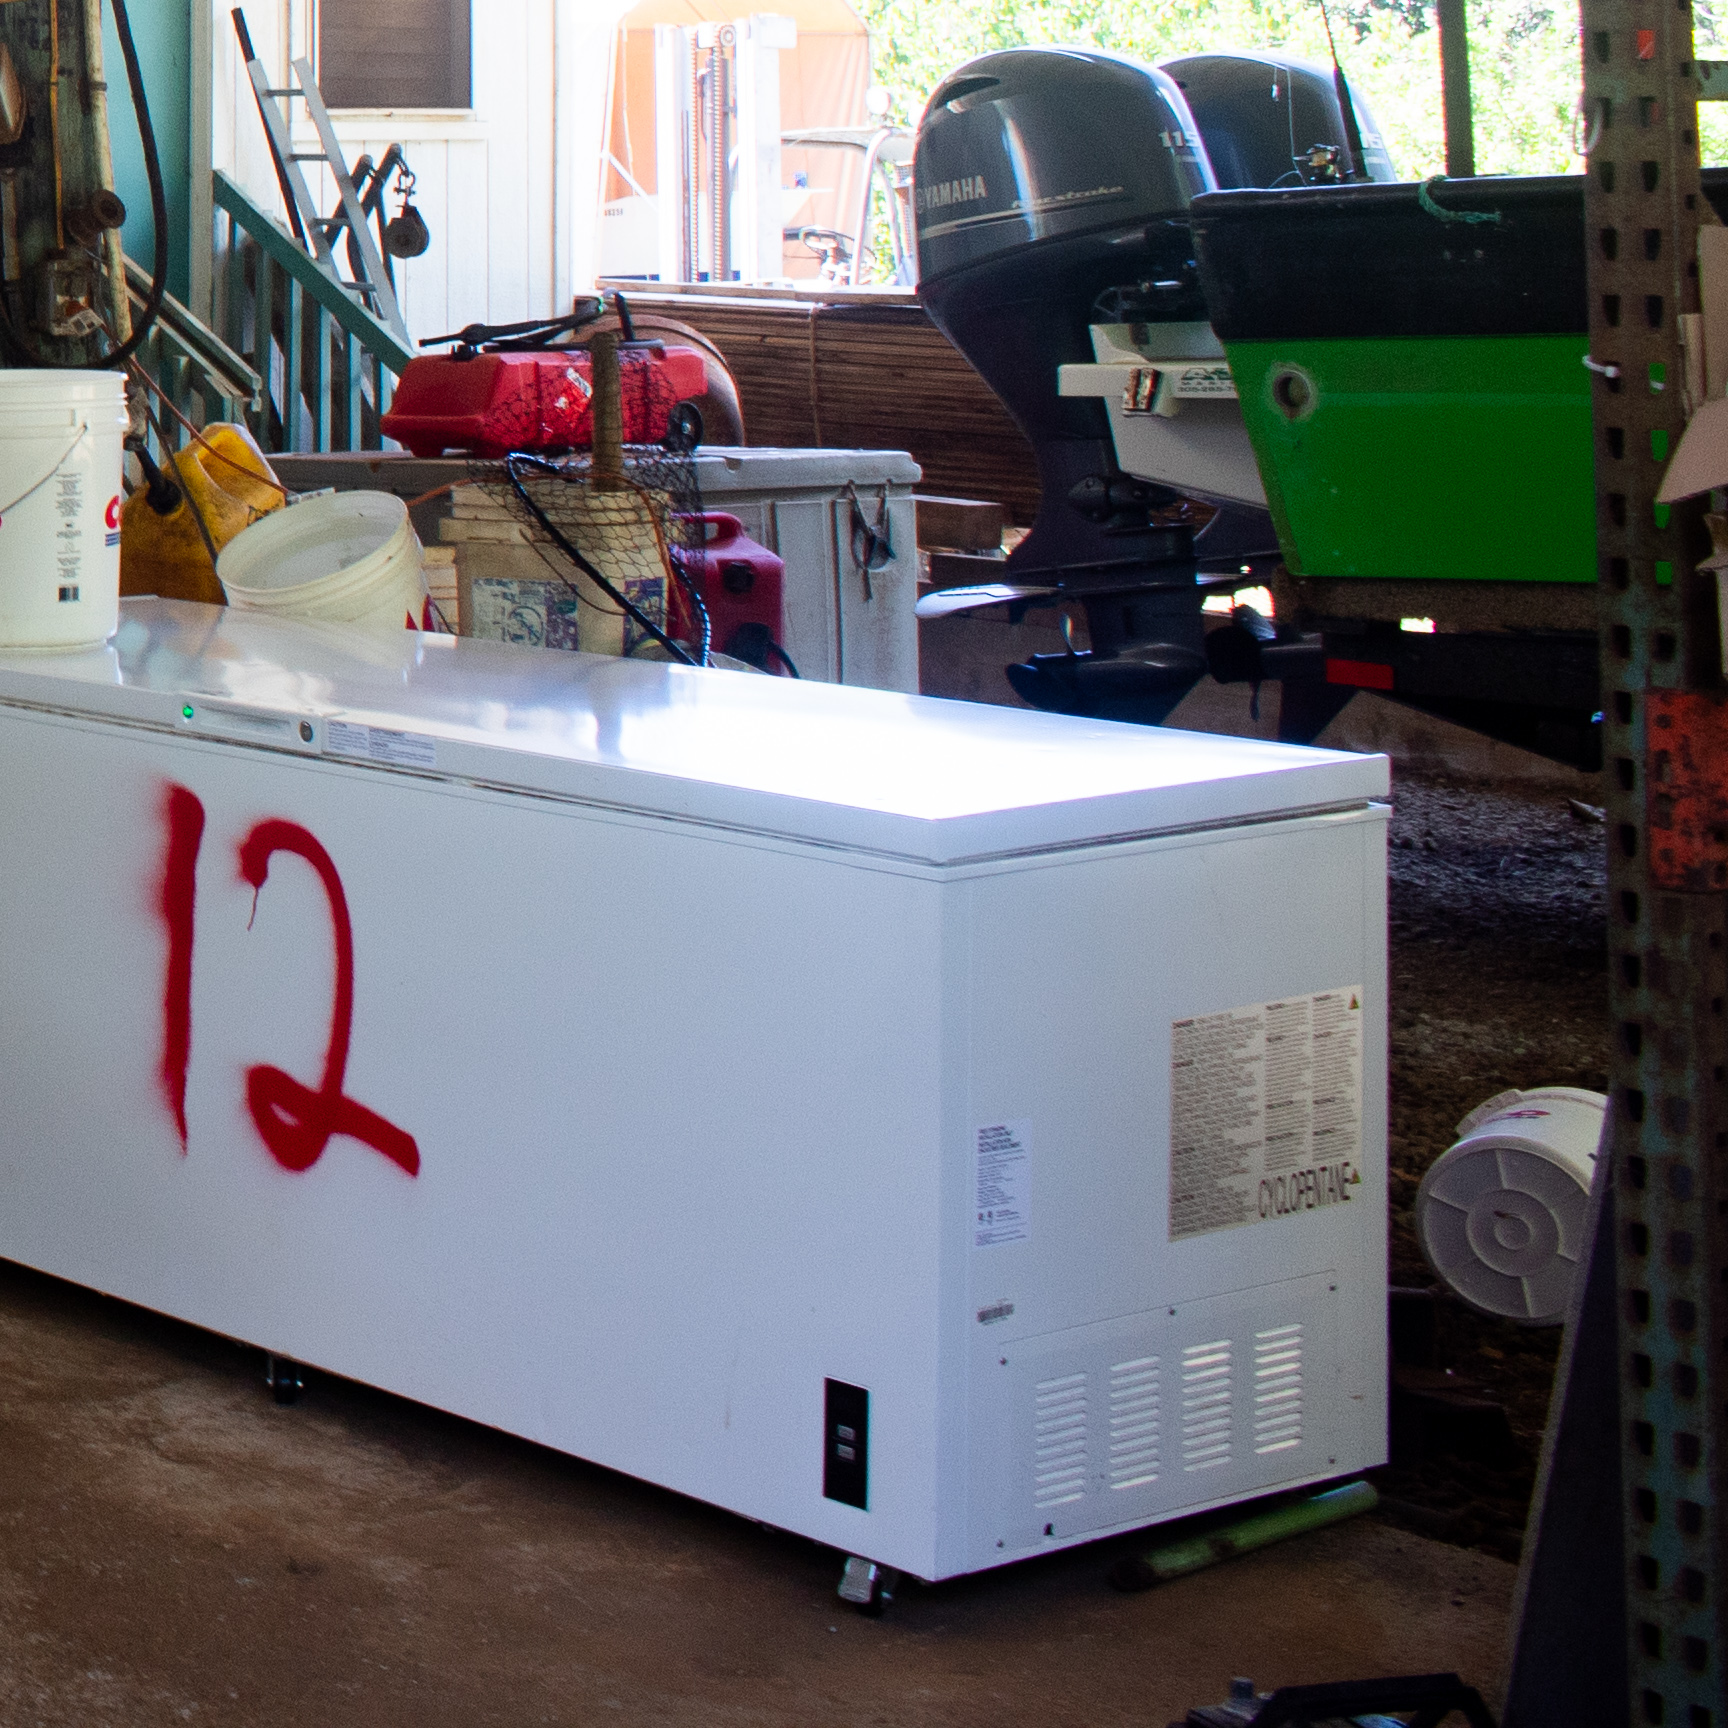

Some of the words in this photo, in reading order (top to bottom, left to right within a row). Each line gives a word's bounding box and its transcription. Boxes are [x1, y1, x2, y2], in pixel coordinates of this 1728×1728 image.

[925, 175, 988, 208] YAMAHA
[154, 777, 422, 1180] 12
[1258, 1161, 1351, 1219] CYCLOPENTANE
